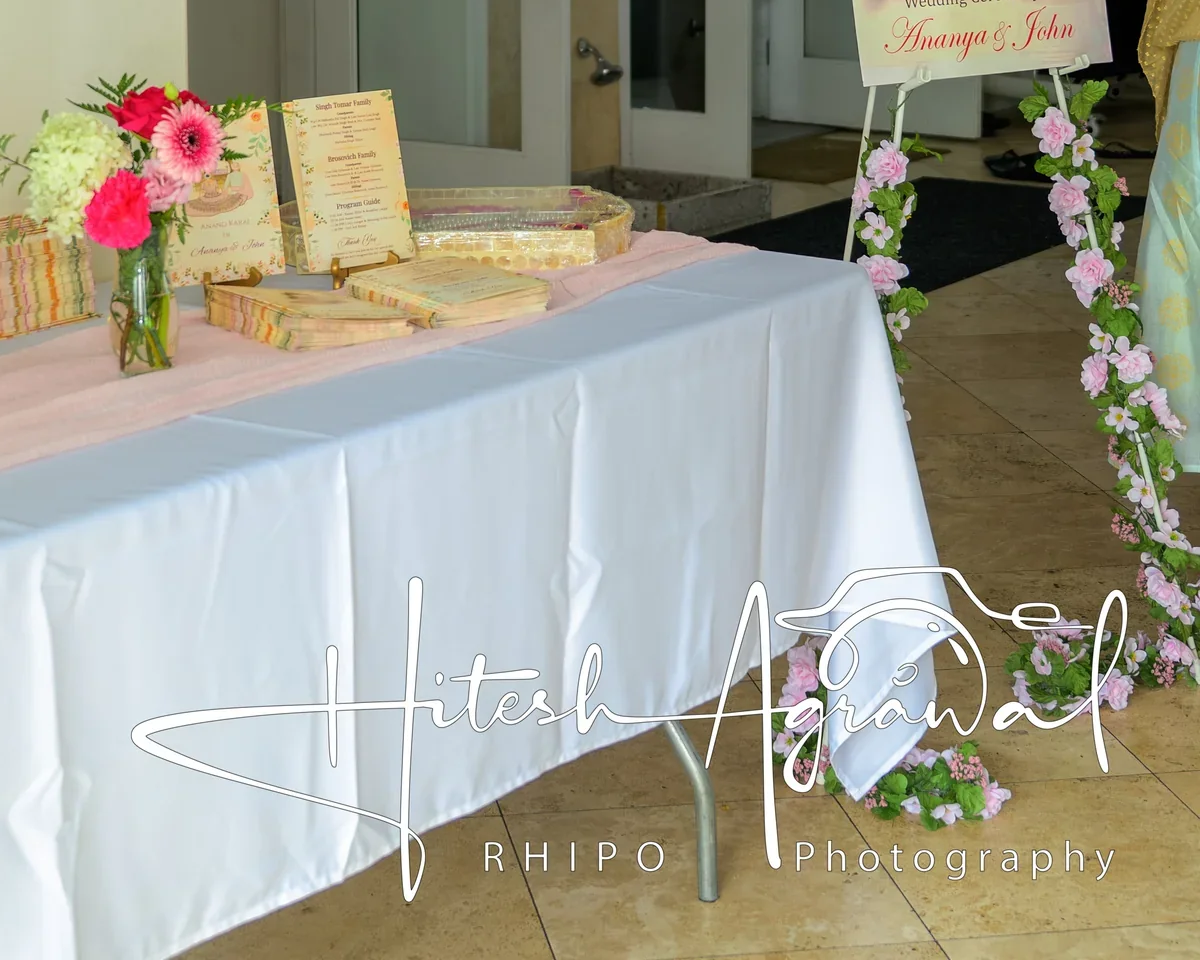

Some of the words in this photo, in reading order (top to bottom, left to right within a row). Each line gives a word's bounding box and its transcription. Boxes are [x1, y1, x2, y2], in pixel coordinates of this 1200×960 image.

[884, 16, 989, 63] Ananya
[992, 21, 1012, 52] &
[1012, 5, 1076, 52] John
[315, 103, 333, 111] Singh
[333, 101, 352, 109] Tomar
[353, 98, 372, 107] Family
[357, 150, 377, 160] Family
[336, 201, 363, 210] Program
[363, 197, 381, 206] Guide
